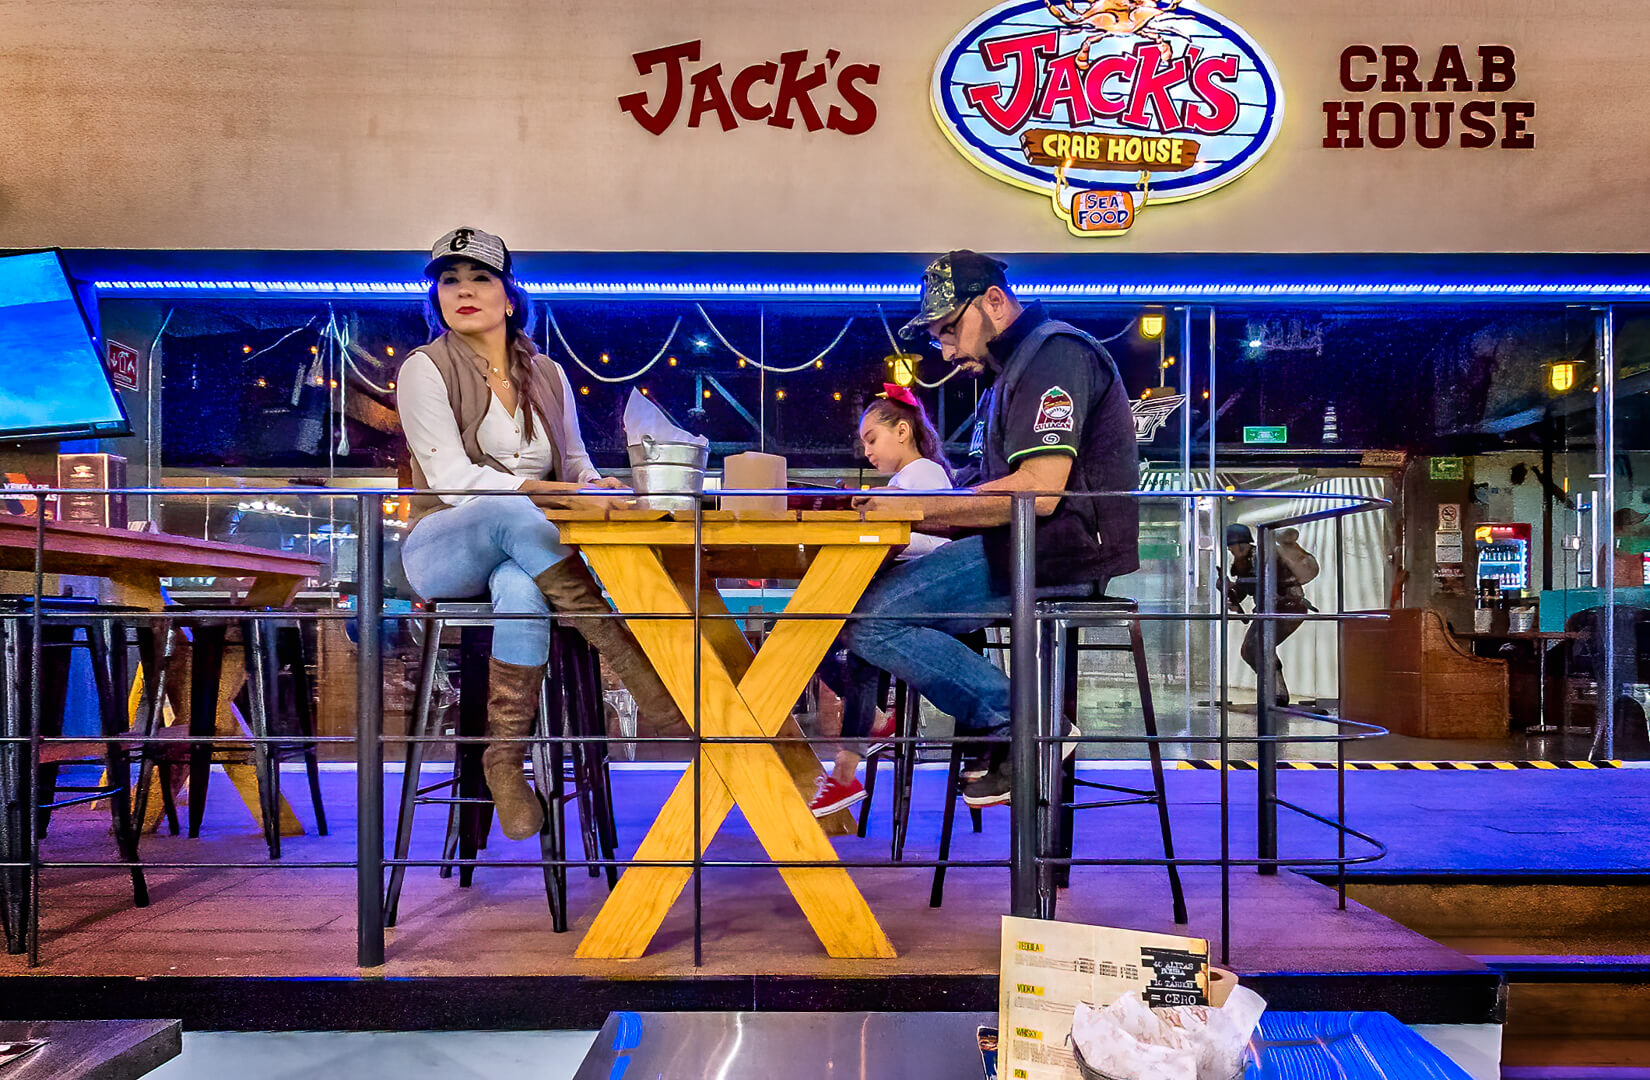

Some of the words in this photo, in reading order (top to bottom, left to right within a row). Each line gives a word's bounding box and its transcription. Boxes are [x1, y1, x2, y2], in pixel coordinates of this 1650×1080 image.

[618, 39, 881, 136] JACK'S
[965, 29, 1240, 135] JACK'S
[1340, 45, 1517, 93] CRAB
[1322, 101, 1536, 149] HOUSE
[1042, 134, 1099, 159] CRAB
[1107, 138, 1184, 164] HOUSE
[1078, 209, 1130, 226] FOOD
[1086, 192, 1120, 210] SEA
[1164, 994, 1197, 1006] CERO
